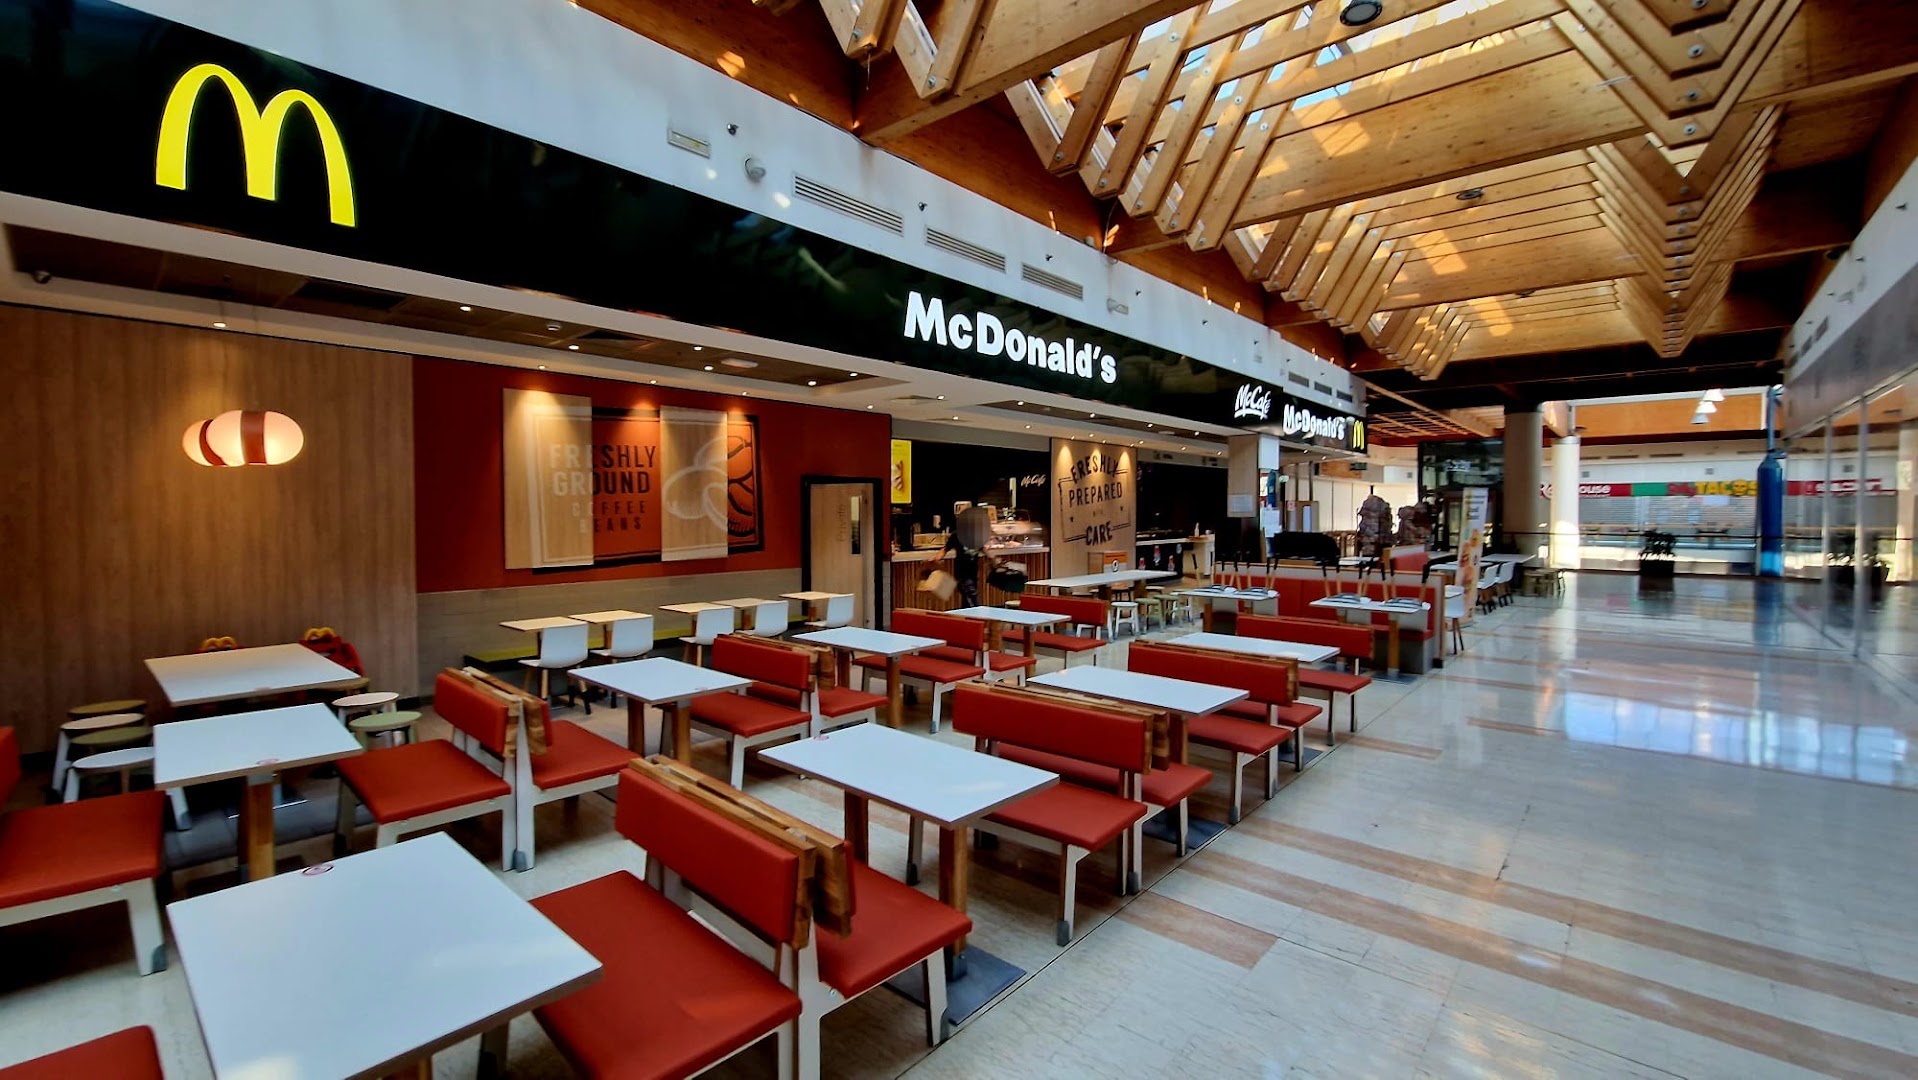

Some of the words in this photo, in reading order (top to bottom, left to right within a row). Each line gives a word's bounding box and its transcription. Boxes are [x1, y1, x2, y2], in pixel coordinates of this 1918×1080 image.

[903, 290, 1118, 384] McDonald's
[1282, 403, 1345, 440] McDonald's
[550, 444, 656, 468] FRESHLY
[1070, 452, 1119, 485] FRESHLY
[553, 471, 650, 496] GROUND
[1068, 481, 1123, 508] PREPARED
[579, 517, 642, 533] BEANS
[1085, 520, 1113, 546] CARE
